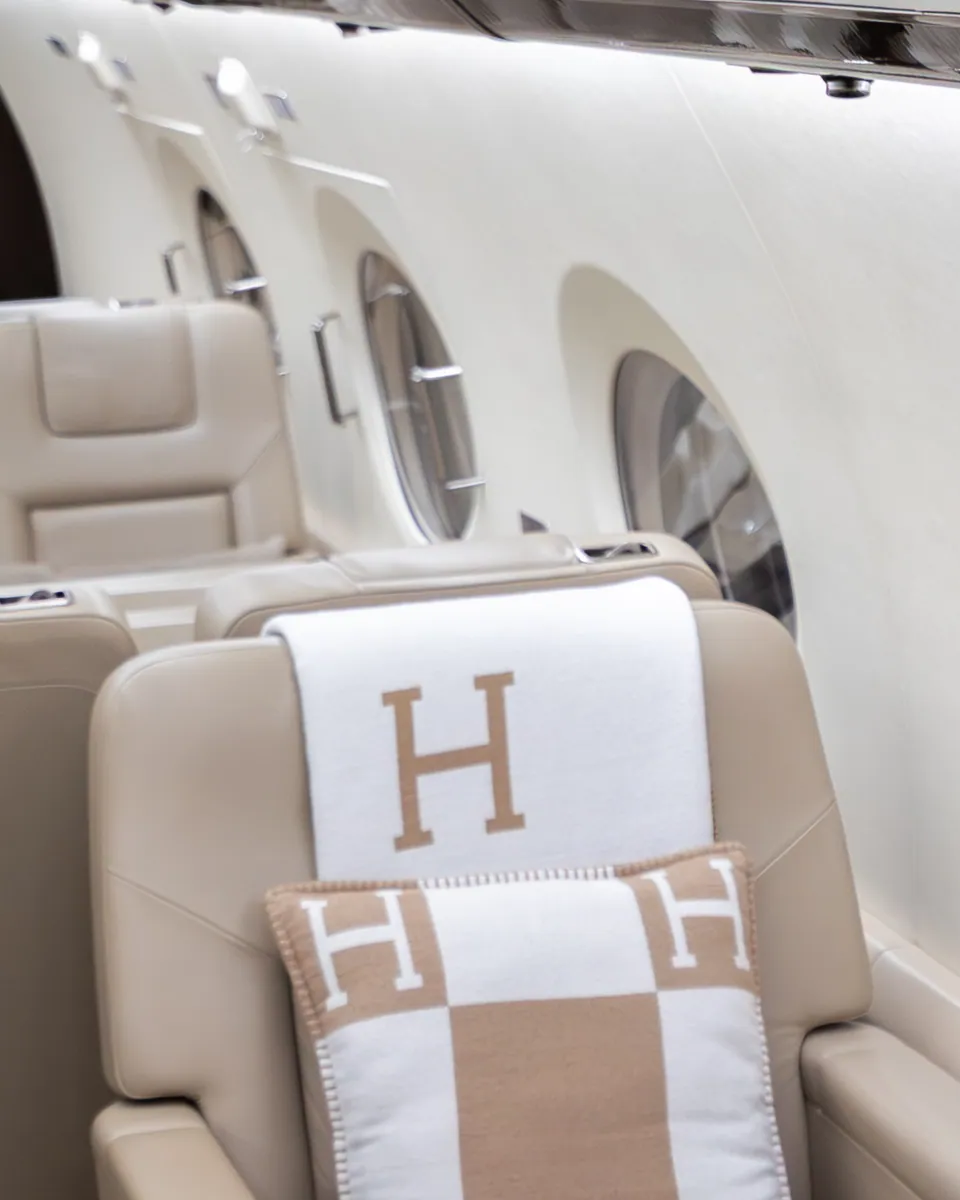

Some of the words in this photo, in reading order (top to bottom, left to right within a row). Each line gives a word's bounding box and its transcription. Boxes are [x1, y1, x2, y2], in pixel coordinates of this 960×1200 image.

[382, 672, 525, 850] H
[300, 888, 424, 1012] H
[641, 858, 750, 970] H
